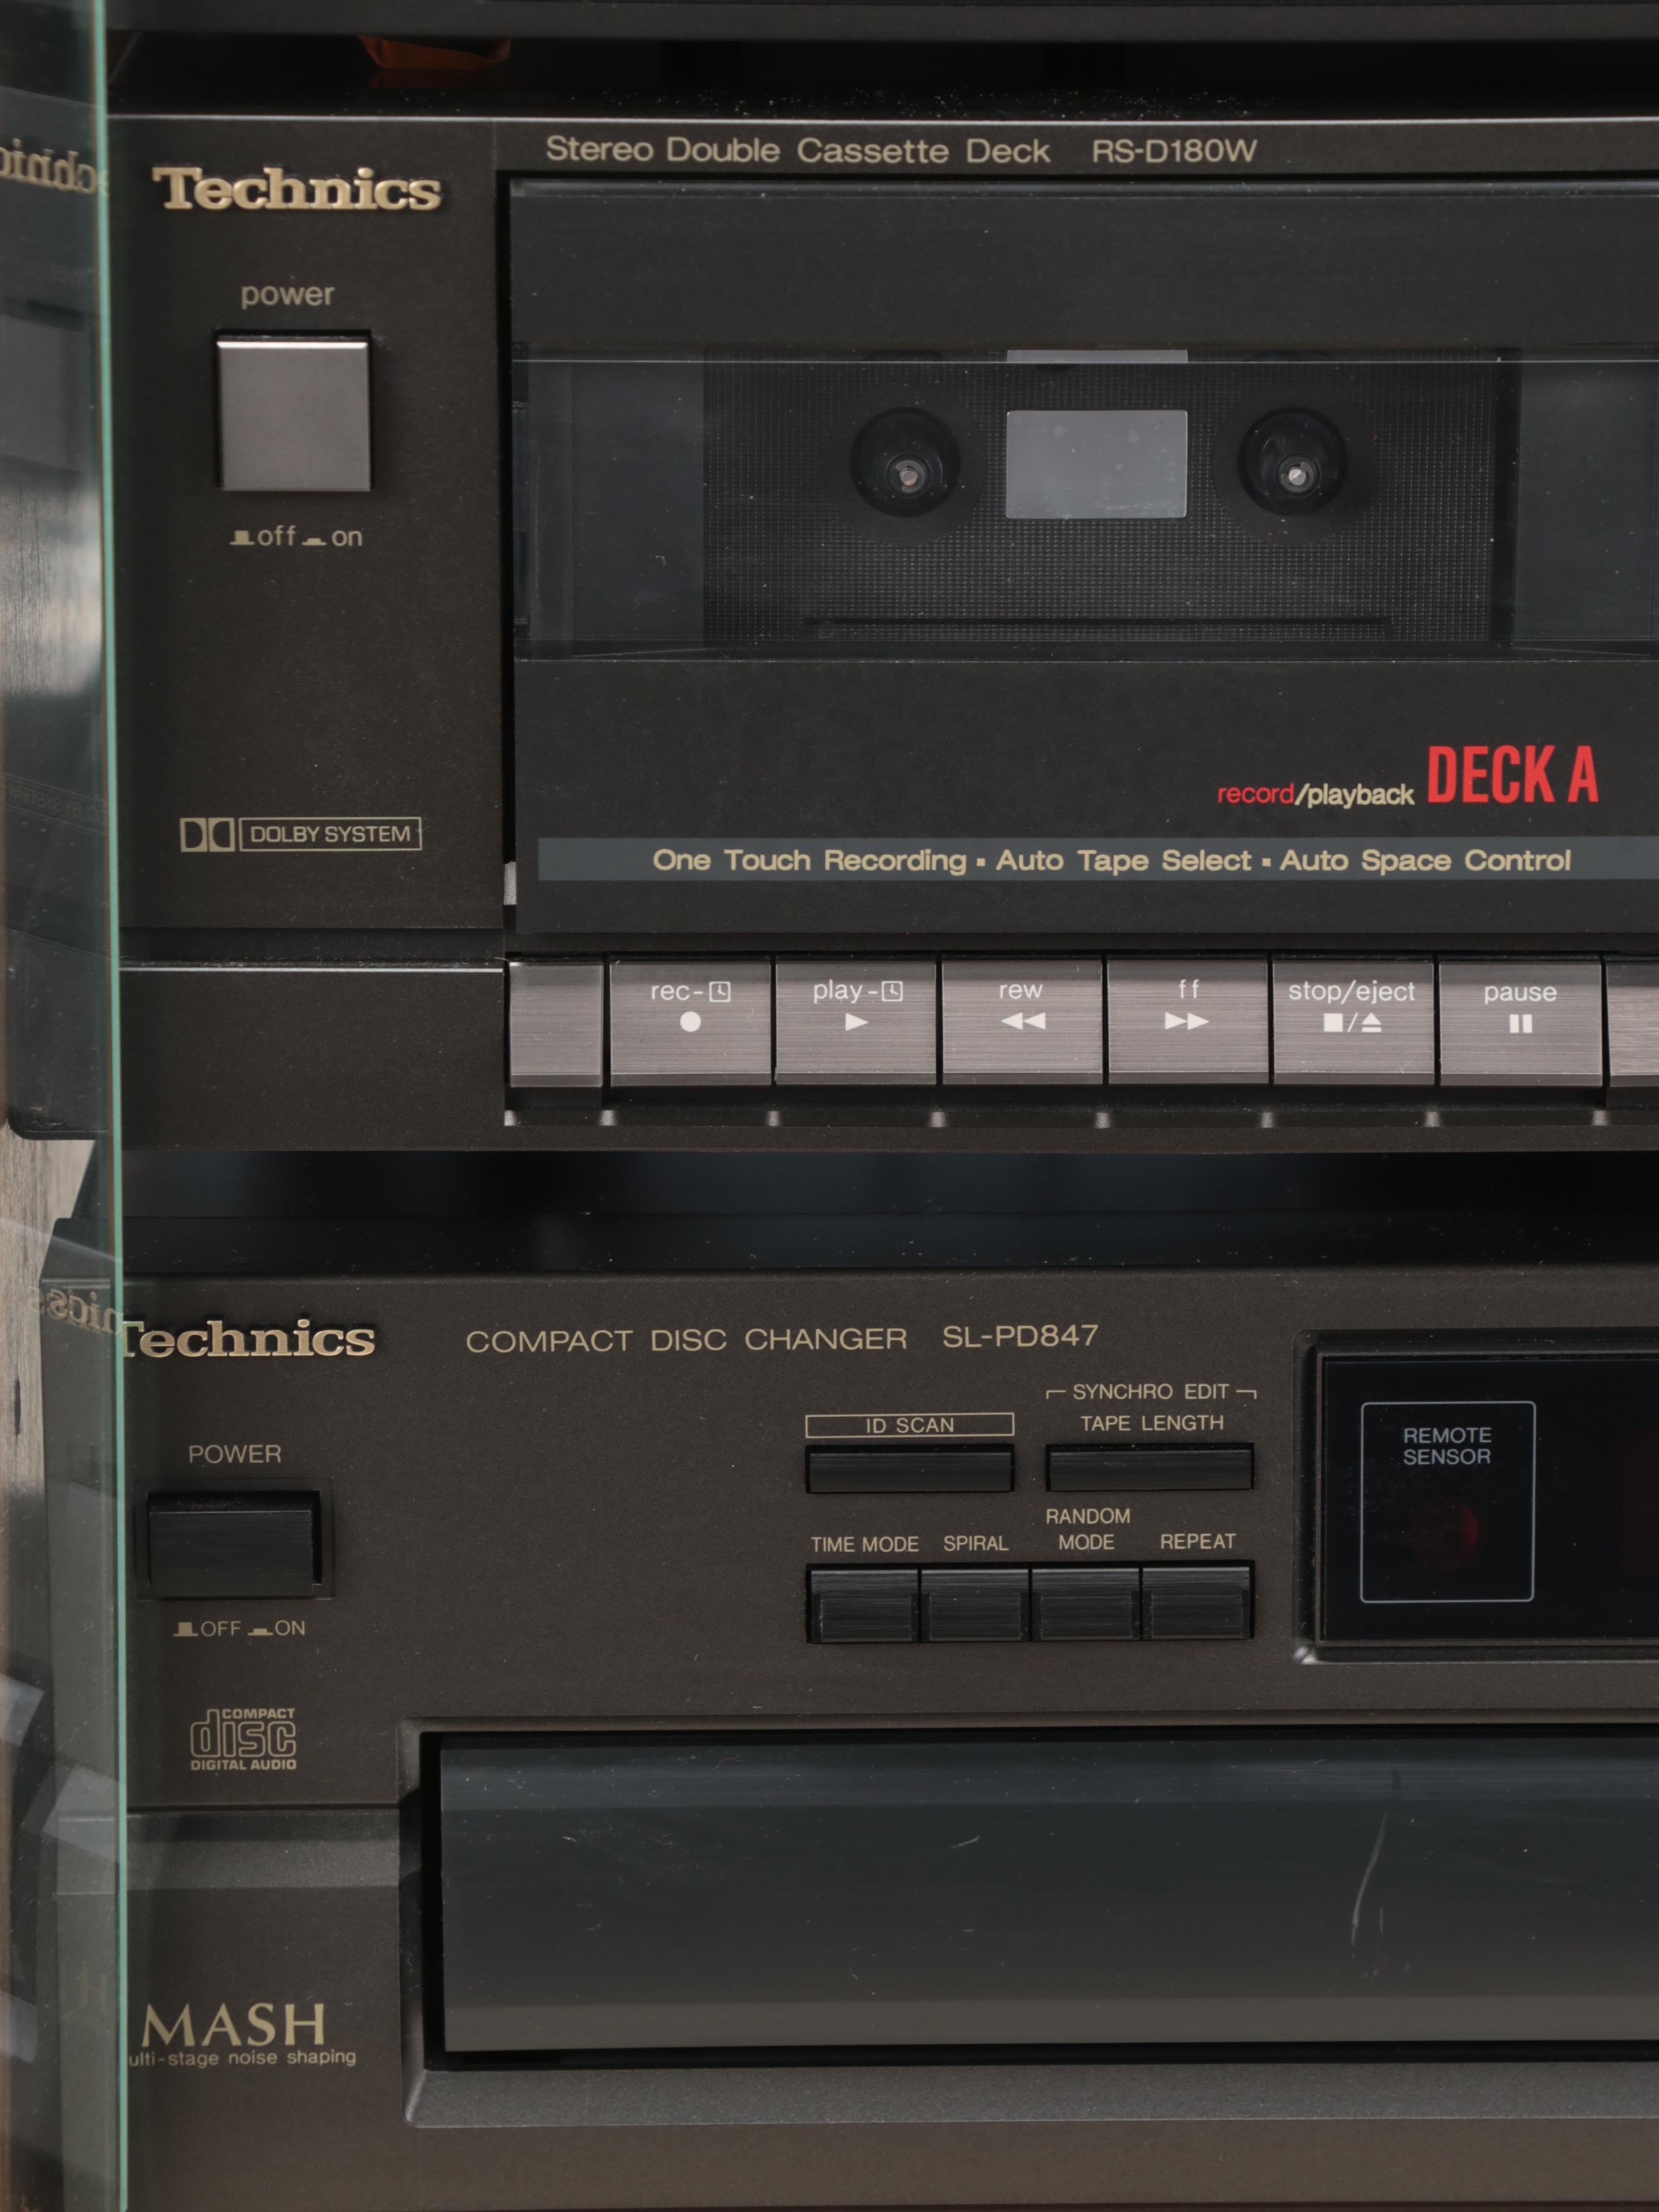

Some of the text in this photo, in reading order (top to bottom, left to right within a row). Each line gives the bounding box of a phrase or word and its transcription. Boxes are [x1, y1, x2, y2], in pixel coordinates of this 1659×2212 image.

[547, 135, 1257, 164] Stereo Double Cassette Deck RS-D180W
[153, 167, 440, 210] Technics
[242, 286, 335, 310] power
[257, 524, 362, 547] off on
[1427, 745, 1599, 804] DECK A
[1218, 783, 1415, 810] record/playback
[251, 826, 410, 843] DOLBY SYSTEM
[653, 848, 1571, 876] One Touch Recording Auto Tape Select Auto Space Control
[1000, 984, 1043, 1000] rew
[1179, 979, 1199, 999] ff
[1288, 980, 1416, 1005] stop/eject
[1485, 986, 1557, 1005] pause
[466, 1324, 1099, 1353] COMPACT DISC CHANGER SL-PD847
[1073, 1383, 1230, 1400] SYNCHRO EDIT
[867, 1417, 954, 1434] ID SCAN
[1080, 1414, 1224, 1431] TAPE LENGTH
[1404, 1427, 1491, 1444] REMOTE
[189, 1444, 281, 1463] POWER
[1404, 1449, 1491, 1465] SENSOR
[1046, 1508, 1130, 1524] RANDOM
[811, 1536, 919, 1553] TIME MODE
[944, 1535, 1009, 1552] SPIRAL
[1059, 1534, 1115, 1551] MODE
[1161, 1533, 1236, 1549] REPEAT
[201, 1620, 305, 1637] OFF ON
[222, 1708, 295, 1719] COMPACT
[191, 1759, 296, 1770] DIGITAL AUDIO
[142, 2003, 324, 2047] MASH
[128, 2049, 356, 2069] ulti-stage noise shaping
